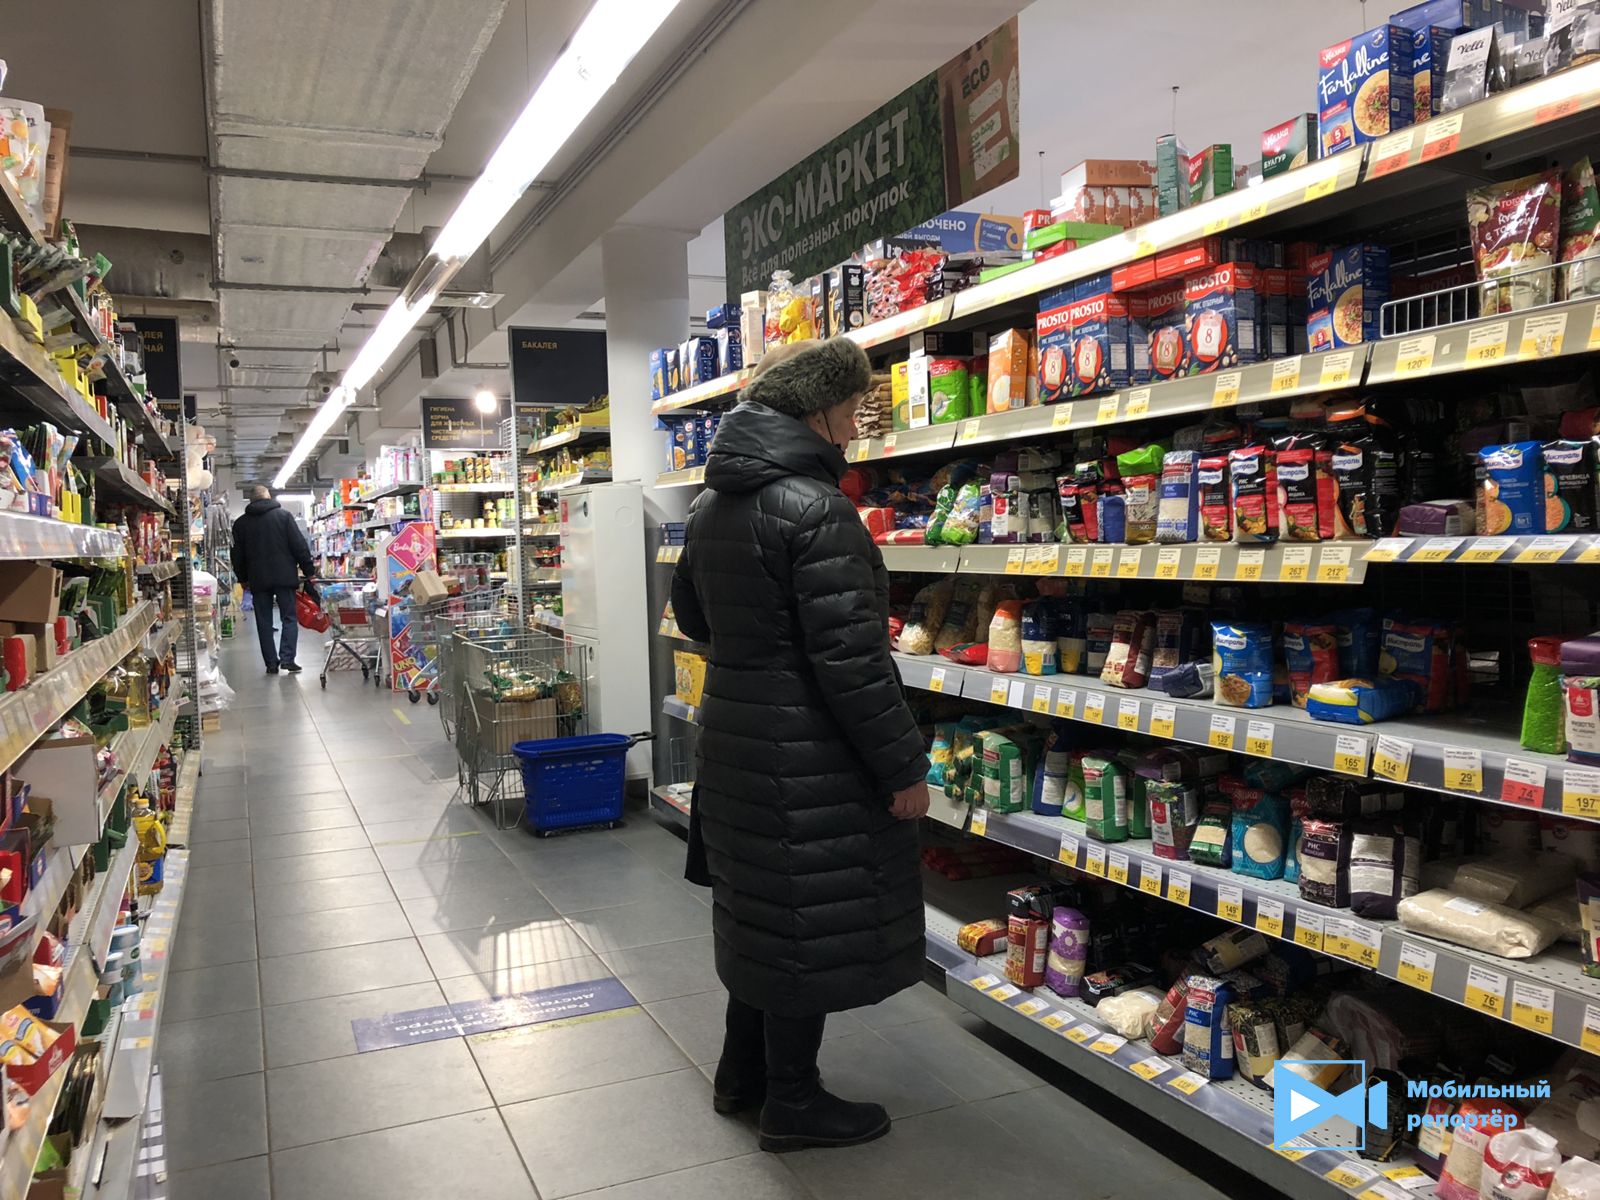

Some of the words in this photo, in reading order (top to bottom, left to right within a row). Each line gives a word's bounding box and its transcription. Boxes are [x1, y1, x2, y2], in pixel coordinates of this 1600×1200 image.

[1457, 38, 1485, 55] Yelli
[961, 59, 990, 99] ECO
[1319, 45, 1390, 105] Farfalline
[1334, 128, 1341, 140] 5
[1263, 153, 1287, 169] БУЛГУР
[741, 106, 909, 260] ЭКО-МАРКЕТ
[917, 218, 967, 232] ЮЧЕНО
[742, 260, 758, 288] Всё
[760, 253, 779, 279] для
[781, 217, 841, 266] полезных
[843, 180, 910, 232] покупок
[913, 233, 941, 242] выгоды
[1186, 270, 1230, 292] PROSTO
[1307, 259, 1363, 308] Farfalline
[1149, 289, 1186, 309] PROSTO
[1070, 300, 1104, 320] PROSTO
[1037, 310, 1069, 330] PROSTO
[1205, 329, 1213, 344] 8
[144, 344, 164, 353] ЧАЙ
[521, 340, 558, 350] БАКАЛЕЯ
[1164, 343, 1171, 356] 8
[1478, 348, 1496, 359] 130
[1085, 355, 1091, 365] 8
[1407, 360, 1422, 370] 120
[1050, 364, 1056, 374] 8
[1280, 379, 1293, 387] 115
[1333, 374, 1342, 382] 69
[1288, 567, 1302, 576] 263
[1327, 567, 1341, 577] 212
[394, 656, 416, 671] UNO
[1217, 735, 1228, 743] 139
[1254, 741, 1266, 750] 149
[1344, 757, 1359, 767] 165
[1382, 759, 1397, 771] 114
[1460, 772, 1473, 782] 29
[1521, 788, 1534, 798] 74
[1576, 797, 1595, 808] 197
[1307, 841, 1320, 850] РИС
[1146, 879, 1156, 888] 213
[1175, 889, 1185, 898] 120
[1225, 905, 1237, 914] 149
[1304, 931, 1317, 943] 139
[1362, 949, 1373, 959] 44
[1484, 994, 1495, 1006] 76
